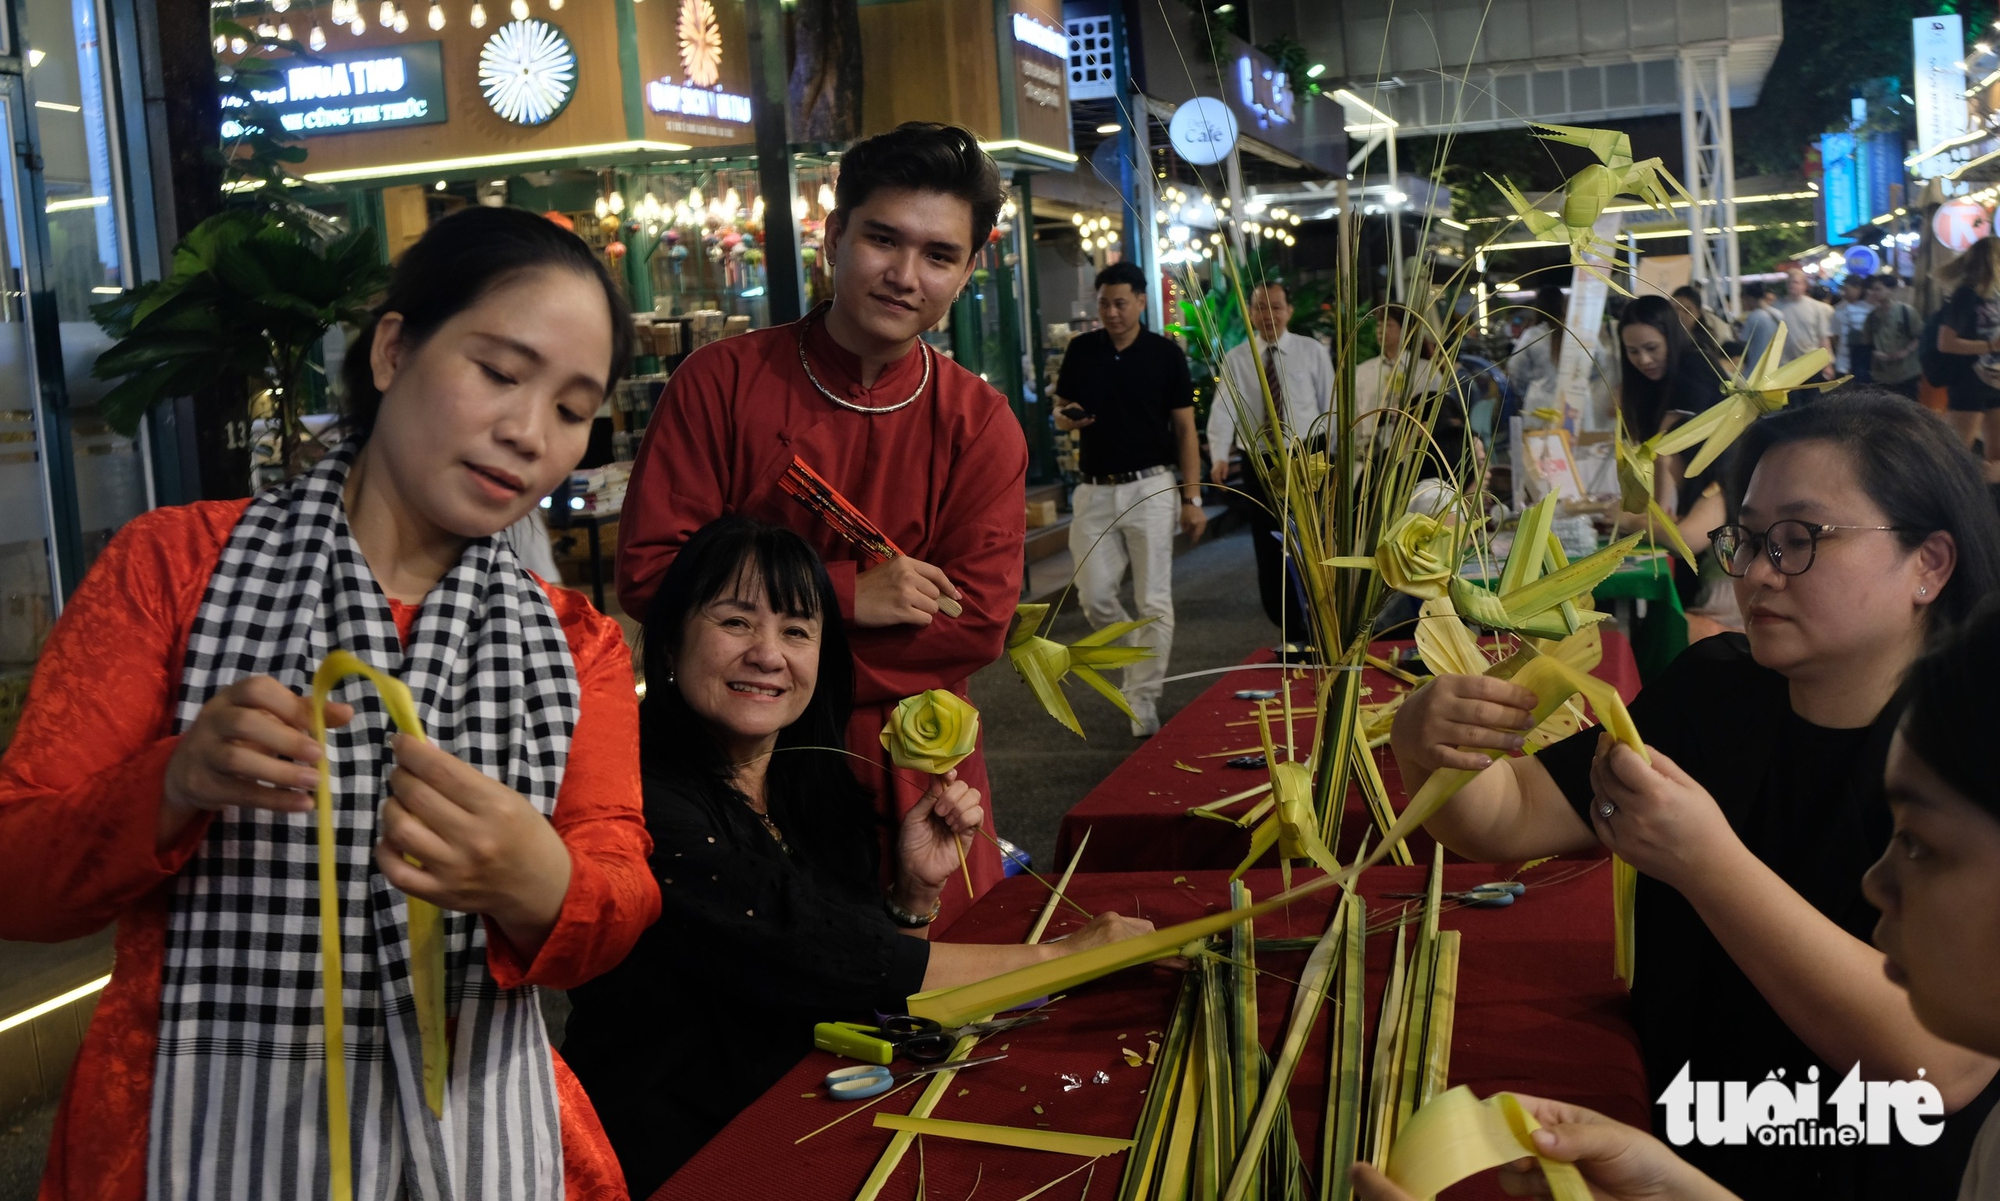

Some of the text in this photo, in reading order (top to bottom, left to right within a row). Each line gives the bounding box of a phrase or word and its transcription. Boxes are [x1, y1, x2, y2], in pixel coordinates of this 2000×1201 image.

[350, 56, 407, 95] THU
[303, 106, 352, 130] CÙNG
[1185, 124, 1223, 143] Café
